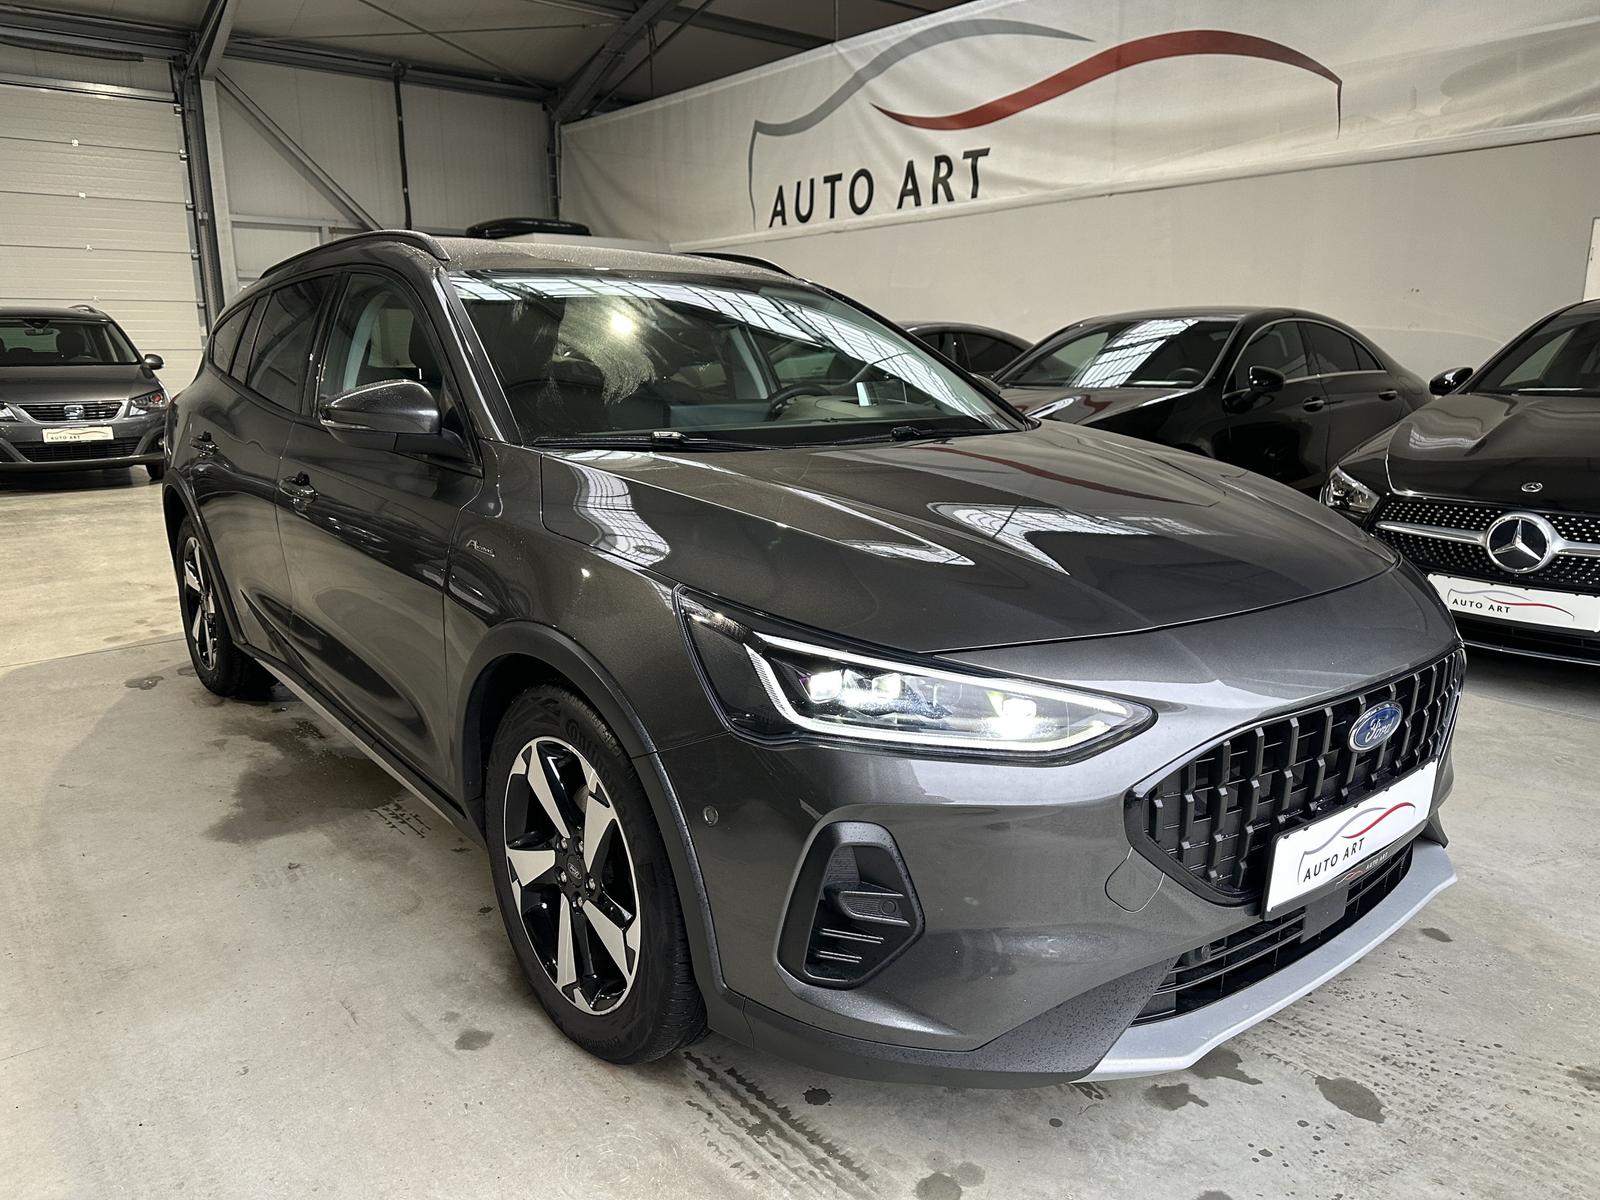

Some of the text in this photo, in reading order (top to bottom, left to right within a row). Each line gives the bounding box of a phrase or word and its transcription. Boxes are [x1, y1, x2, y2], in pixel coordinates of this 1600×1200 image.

[768, 147, 991, 228] AUTO ART
[1452, 599, 1510, 614] AUTO ART
[1364, 716, 1395, 743] Ford
[1303, 837, 1365, 883] AUTO ART
